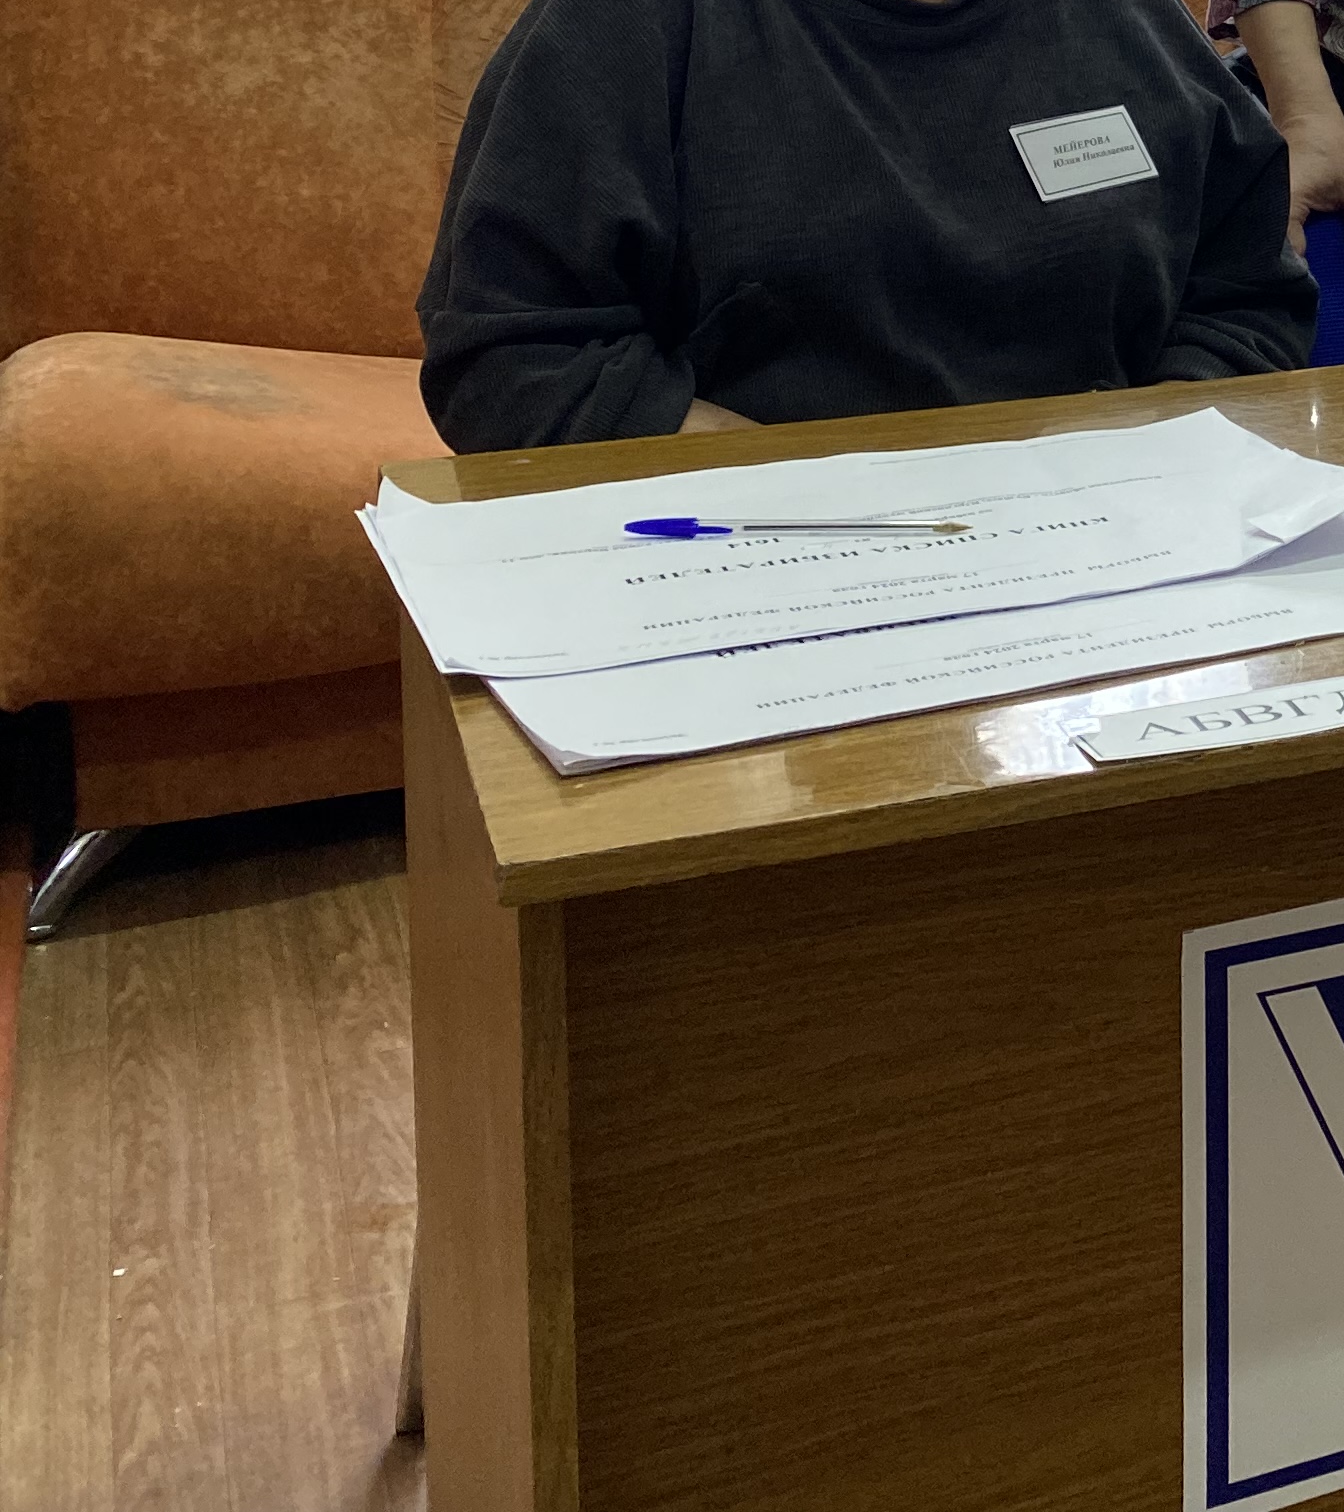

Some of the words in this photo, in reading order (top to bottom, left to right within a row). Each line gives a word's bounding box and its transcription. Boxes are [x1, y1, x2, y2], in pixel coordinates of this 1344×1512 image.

[1053, 135, 1111, 155] МЕЙЕРОВА
[1053, 156, 1081, 169] Юлия
[1082, 143, 1135, 163] Николаевна
[1008, 516, 1109, 536] КНИГА
[870, 532, 999, 554] СПИСКА
[625, 550, 860, 586] ИЗБИРАТЕЛЕЙ
[1062, 627, 1195, 656] ПРЕЗИДЕНТА
[905, 653, 1055, 684] РОССИЙСКОЙ
[756, 680, 897, 709] ФЕДЕРАЦИИ
